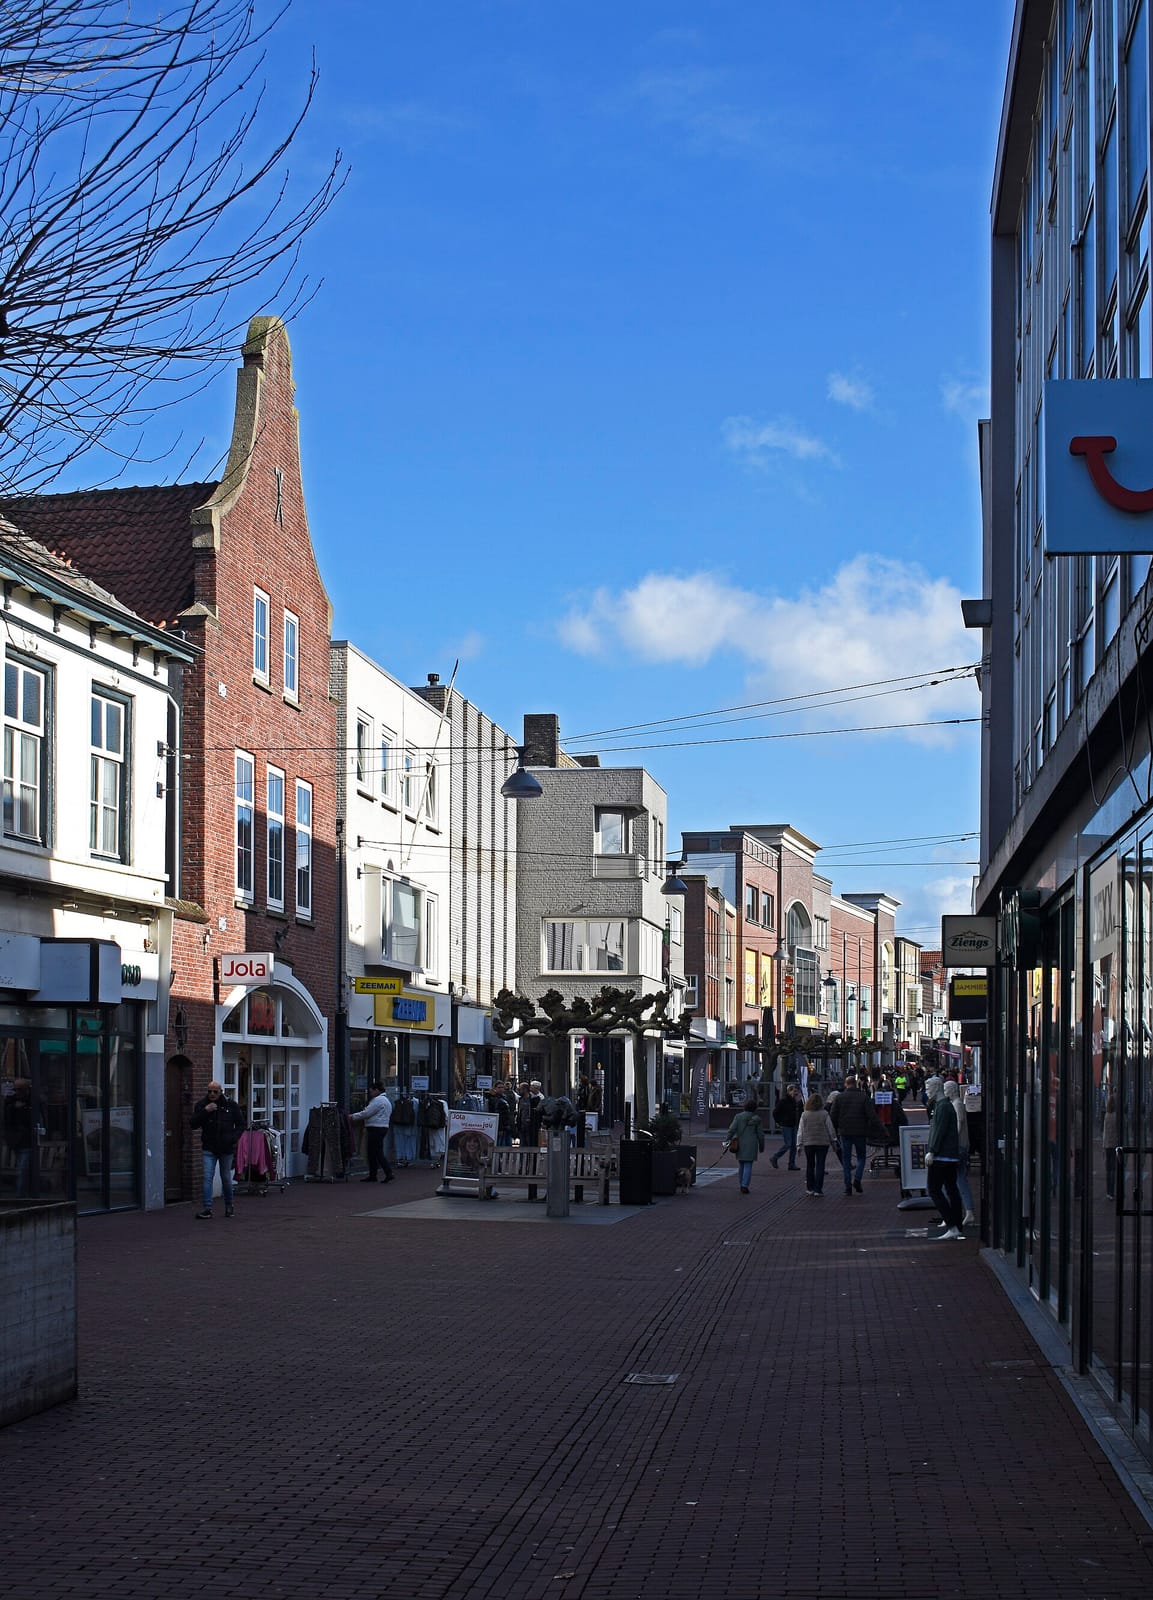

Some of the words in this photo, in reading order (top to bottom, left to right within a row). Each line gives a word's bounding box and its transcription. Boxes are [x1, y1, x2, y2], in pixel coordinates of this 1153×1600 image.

[951, 936, 989, 949] Ziengs
[224, 960, 266, 976] Jola
[360, 982, 396, 990] ZEEMAN
